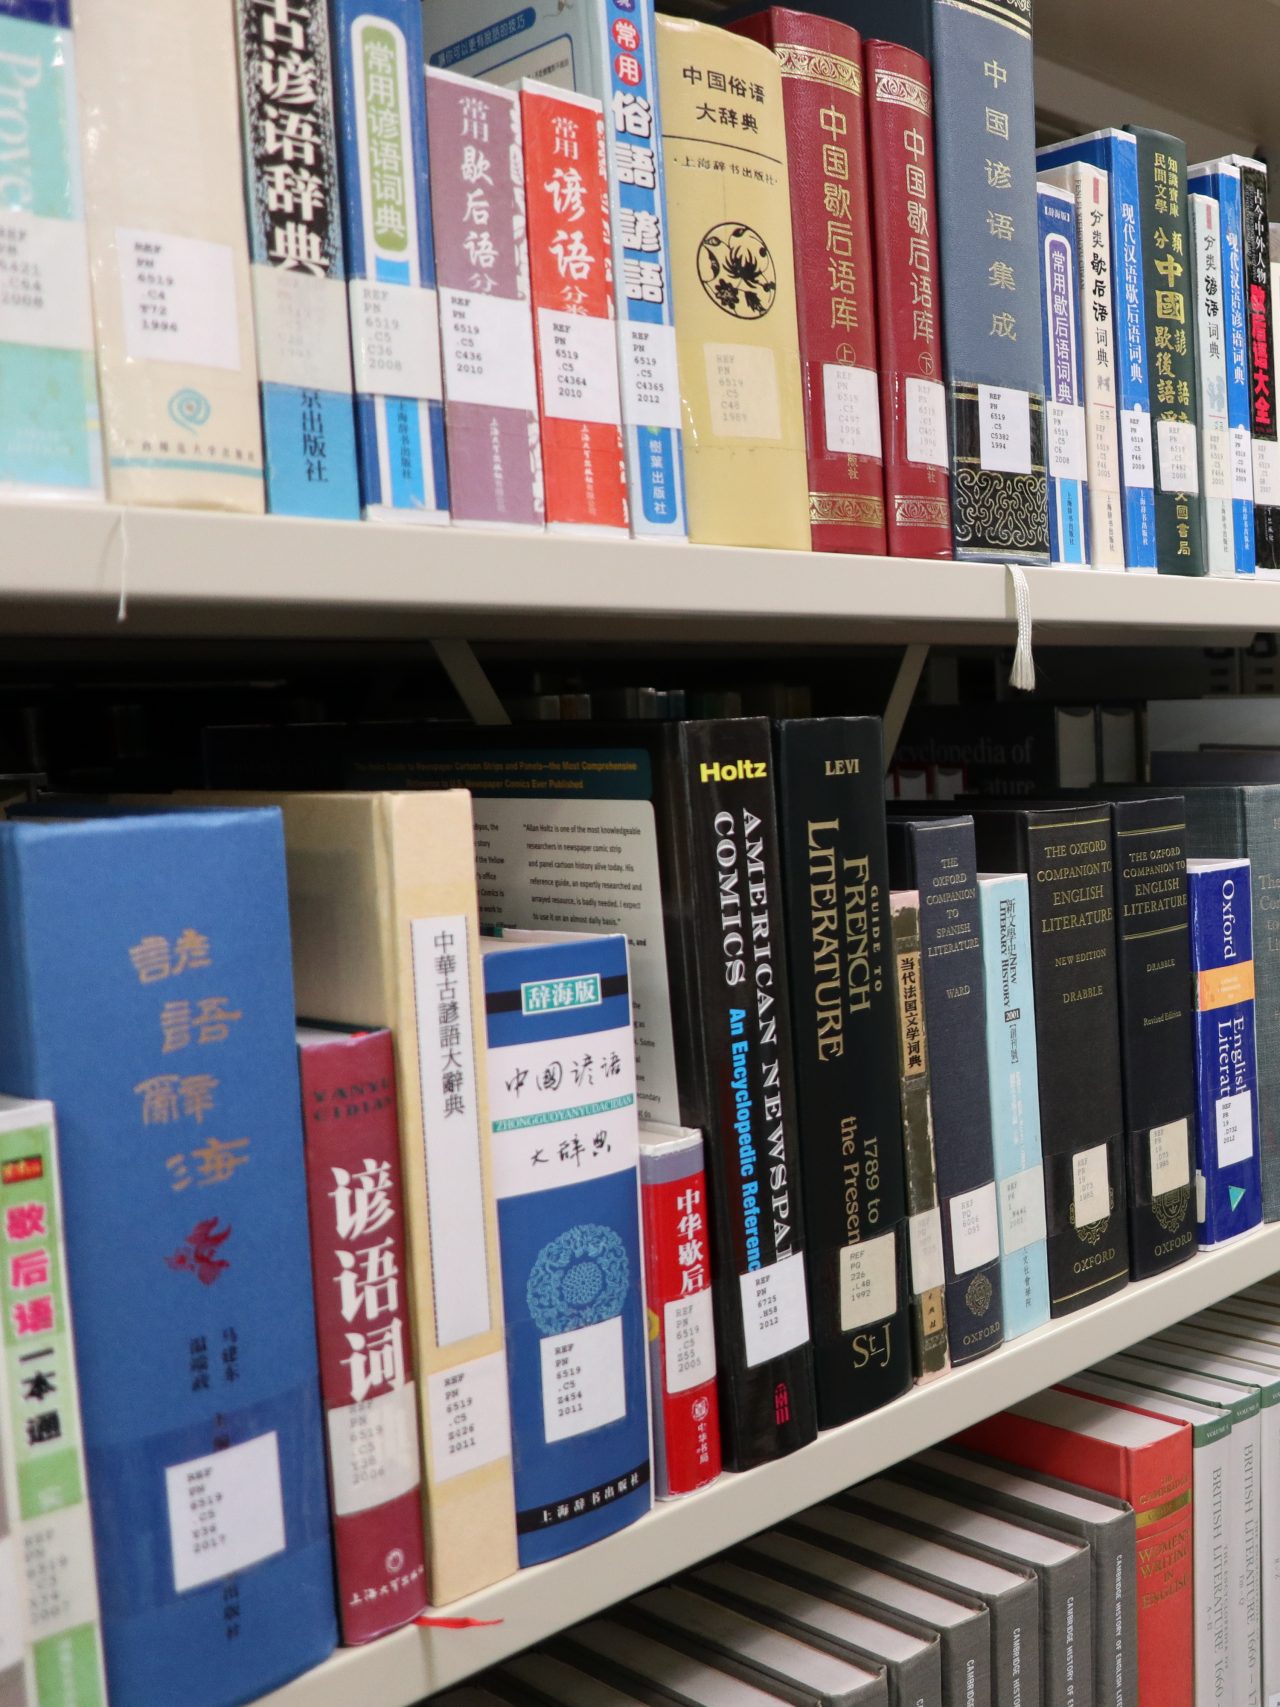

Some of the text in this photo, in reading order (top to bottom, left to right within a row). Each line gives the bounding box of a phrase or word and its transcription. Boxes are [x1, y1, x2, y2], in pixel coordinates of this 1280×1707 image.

[612, 18, 642, 85] 常用
[682, 64, 766, 106] 中国俗语
[695, 102, 759, 136] 大辞典
[364, 39, 407, 240] 常用谚语词典
[1154, 152, 1168, 214] 民間文學
[982, 59, 1017, 343] 中国谚语集成
[818, 104, 859, 333] 中国歇后语库
[903, 127, 934, 345] 中国歇后语库
[1090, 208, 1109, 368] 分类歇后语词典
[1121, 203, 1143, 384] 现代汉语歇后语词典
[1154, 253, 1186, 325] 中國
[1203, 234, 1221, 360] 分类谚语词典
[454, 323, 481, 335] 6519
[1051, 250, 1073, 404] 常用歇后语词典
[455, 350, 483, 362] C436
[555, 349, 580, 361] 6519
[634, 356, 657, 367] 6519
[457, 363, 484, 376] 2010
[557, 375, 588, 388] C4364
[559, 386, 583, 399] 2010
[636, 381, 665, 393] C4365
[637, 393, 661, 405] 2012
[990, 412, 1006, 421] 6519
[991, 442, 1007, 451] 1994
[648, 439, 669, 516] 樹葉出版社
[699, 759, 768, 783] Holtz
[825, 758, 861, 777] LEVI
[1044, 839, 1107, 859] THE OXFORD
[1128, 846, 1182, 863] THE OXFORD
[940, 857, 960, 869] THE
[1036, 863, 1100, 884] COMPANION
[1123, 860, 1186, 879] COMPANION TO
[932, 873, 967, 888] OXFORD
[1134, 877, 1180, 897] ENGLISH
[713, 810, 746, 987] COMICS
[925, 887, 977, 906] COMPANION
[1053, 884, 1105, 906] ENGLISH
[1122, 893, 1188, 917] LITERATURE
[742, 807, 778, 1046] AMERICAN
[946, 908, 960, 920] TO
[1041, 907, 1113, 934] LITERATURE
[1221, 878, 1237, 961] Oxford
[807, 817, 845, 1062] LITERATURE
[843, 854, 872, 1015] FRENCH
[869, 885, 883, 993] GUIDE TO
[935, 922, 972, 939] SPANISH
[927, 936, 981, 958] LITERATURE
[999, 899, 1011, 1008] LITERARY HISTORY
[1055, 948, 1107, 968] NEW EDITION
[1146, 958, 1176, 973] DRABBLE
[528, 978, 598, 1010] 辞海版
[945, 984, 972, 1001] WARD
[1062, 985, 1104, 1004] DRABBLE
[432, 929, 468, 1119] 中華古諺語大辭典
[729, 1008, 747, 1037] An
[899, 956, 923, 1069] 当代法国文学词典
[1005, 1008, 1021, 1023] 2001
[1164, 1009, 1182, 1022] Edition
[731, 1040, 758, 1178] Encyclopedic
[529, 1129, 613, 1168] 大辞典
[840, 1115, 858, 1157] the
[863, 1135, 881, 1225] 1789 to
[676, 1188, 705, 1299] 中华歇后
[1154, 1231, 1193, 1257] OXFORD
[1073, 1248, 1116, 1275] OXFORD
[327, 1158, 406, 1403] 谚语词
[850, 1270, 867, 1282] 226
[757, 1295, 778, 1309] 6725
[851, 1289, 872, 1302] 1992
[5, 1203, 63, 1446] 歇后语一本通
[760, 1316, 780, 1330] 2012
[962, 1322, 1001, 1347] OXFORD
[556, 1366, 582, 1381] 6519
[677, 1358, 702, 1373] 2005
[557, 1403, 584, 1418] 2011
[697, 1422, 709, 1465] 中华书局
[540, 1472, 641, 1525] 上海辞书出版社
[1243, 1444, 1256, 1626] BRITISH LITERATURE
[1211, 1466, 1225, 1654] BRITISH LITERATURE
[1115, 1553, 1123, 1686] CAMBRIDGE HISTORY OF ENGLISH
[1012, 1627, 1021, 1677] CAMBRIDGE
[1066, 1596, 1075, 1696] CAMBRIDGE HISTORY OF
